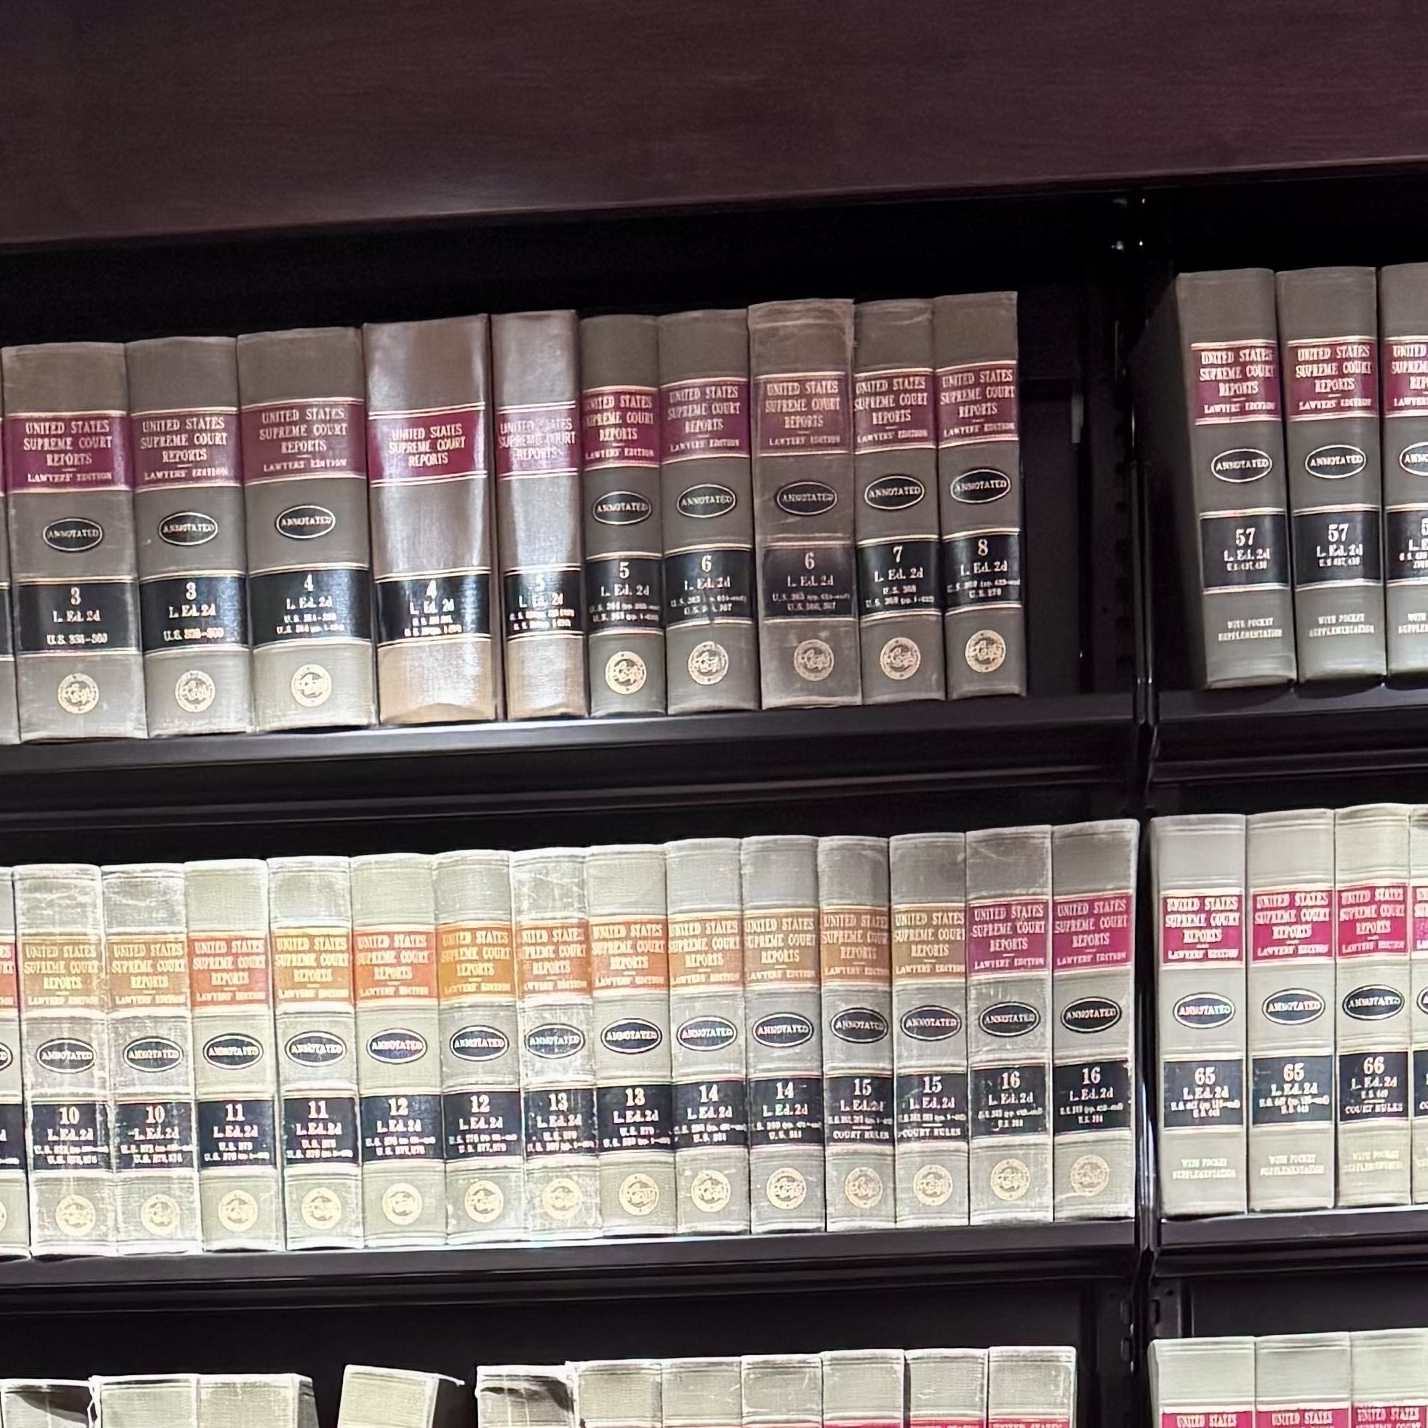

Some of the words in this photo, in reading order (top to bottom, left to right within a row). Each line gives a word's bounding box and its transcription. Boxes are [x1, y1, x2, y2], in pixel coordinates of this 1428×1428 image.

[941, 372, 975, 388] UNITED
[980, 370, 1013, 383] STATES
[958, 402, 998, 418] REPORTS
[1235, 527, 1256, 547] 57
[892, 545, 903, 563] 7
[977, 539, 988, 556] 8
[974, 908, 1006, 921] UNITED
[1010, 905, 1044, 919] STATES
[972, 922, 1012, 938] SUPREME
[1017, 921, 1045, 934] COURT
[990, 938, 1028, 953] REPORTS
[923, 1075, 943, 1094] 15
[1001, 1070, 1021, 1090] 16
[1194, 1066, 1216, 1086] 65
[698, 1083, 719, 1103] 14
[387, 1097, 409, 1116] 12
